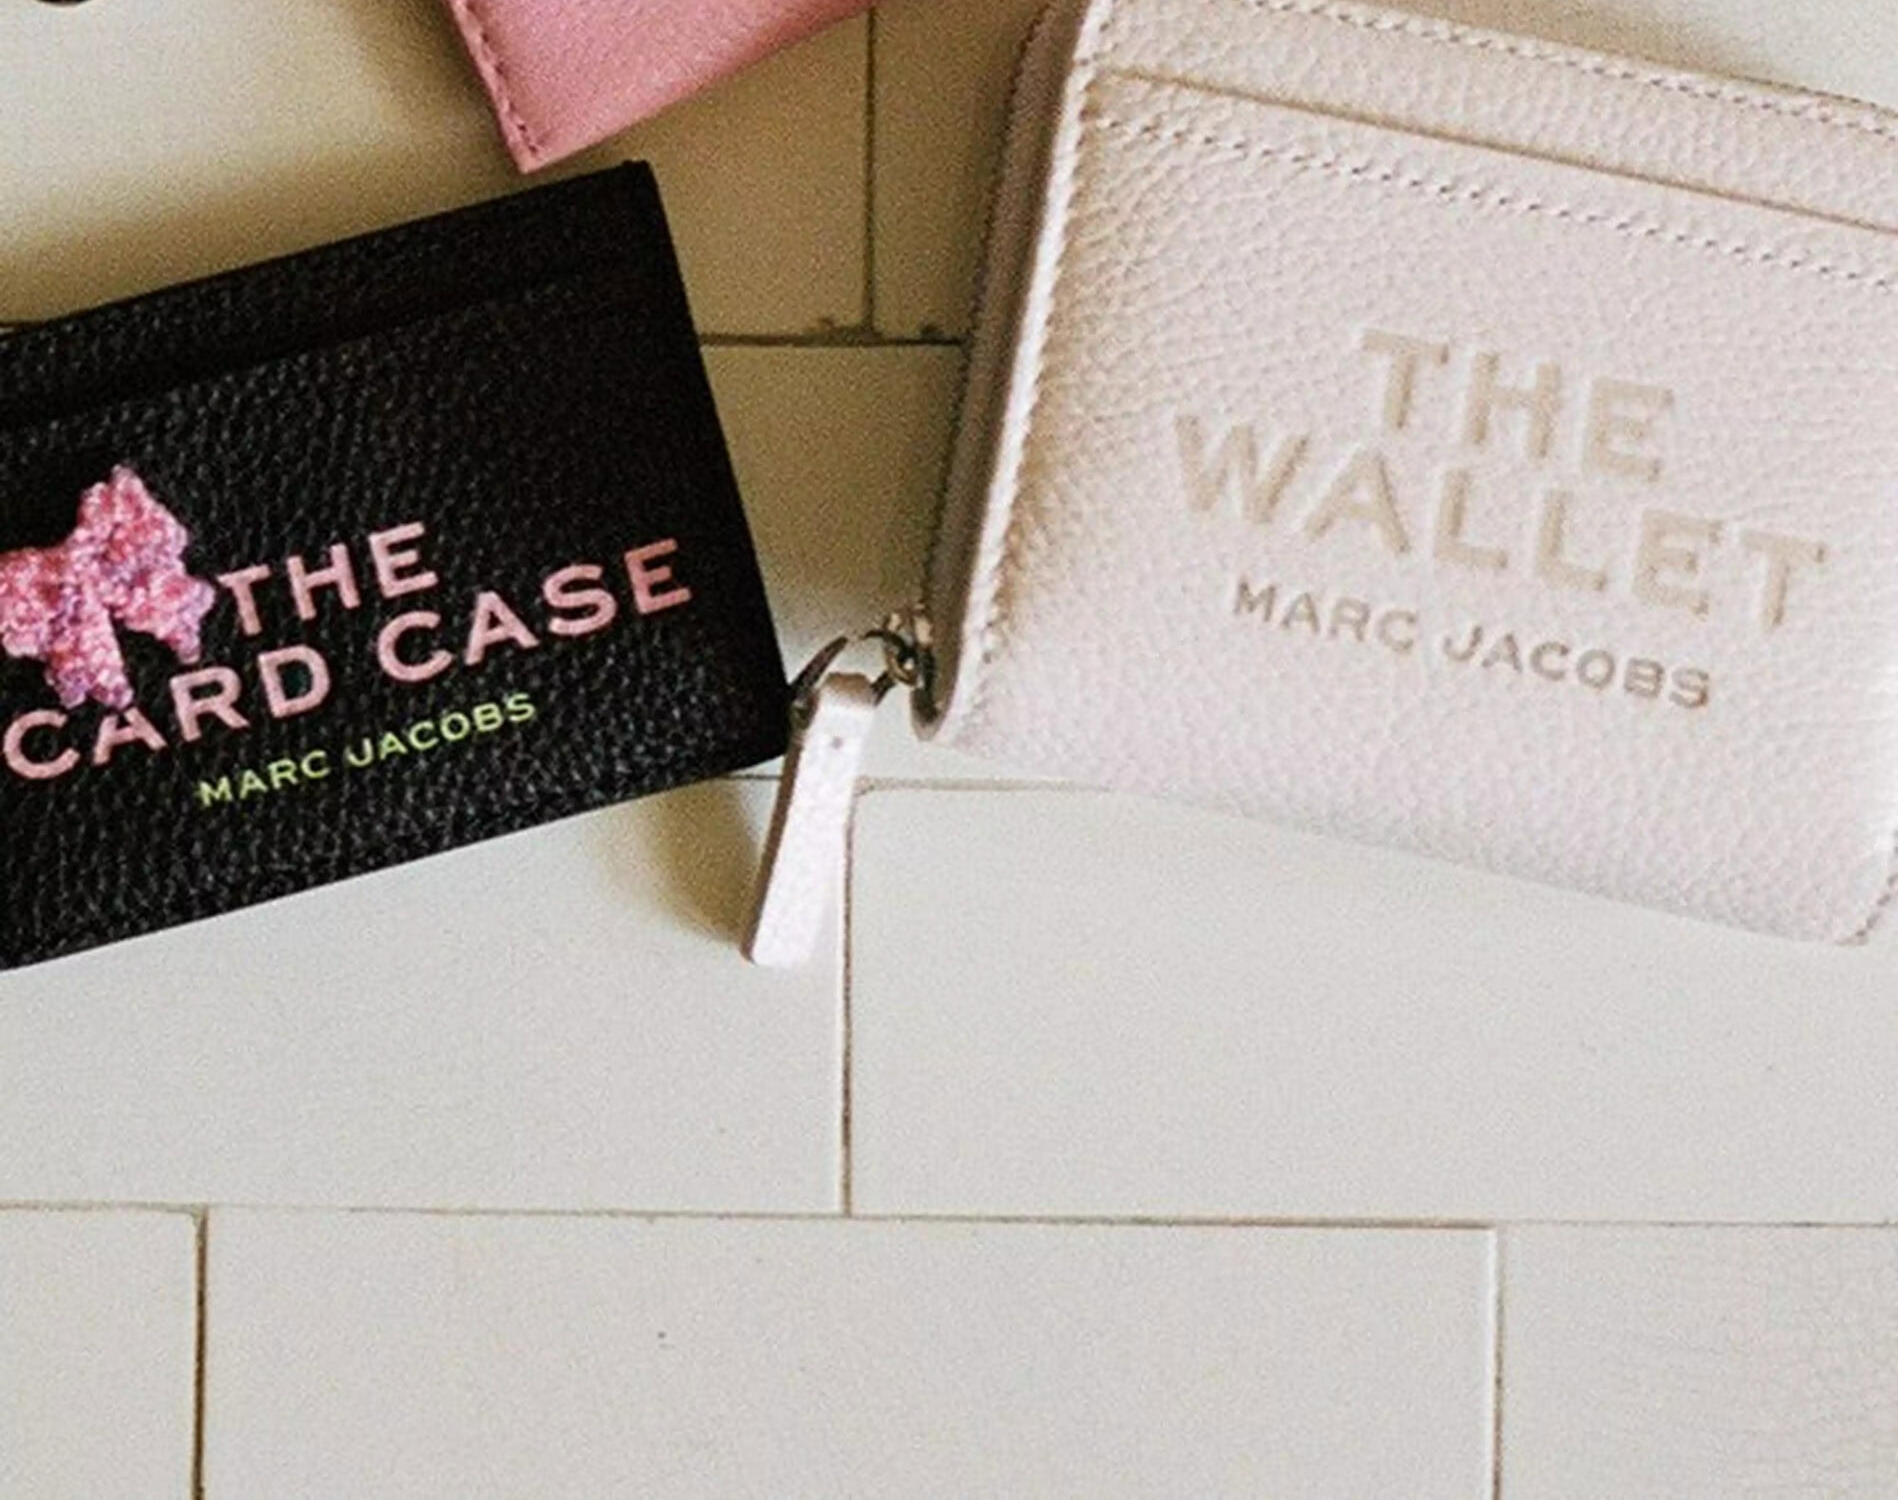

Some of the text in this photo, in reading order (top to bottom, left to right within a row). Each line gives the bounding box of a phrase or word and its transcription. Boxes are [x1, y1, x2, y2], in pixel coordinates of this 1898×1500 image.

[1362, 328, 1675, 483] THE
[217, 521, 439, 637] THE
[1173, 413, 1829, 632] WALLET
[2, 537, 692, 781] CARD CASE
[1232, 573, 1712, 709] MARC JACOBS
[200, 692, 538, 806] MARC JACOBS
